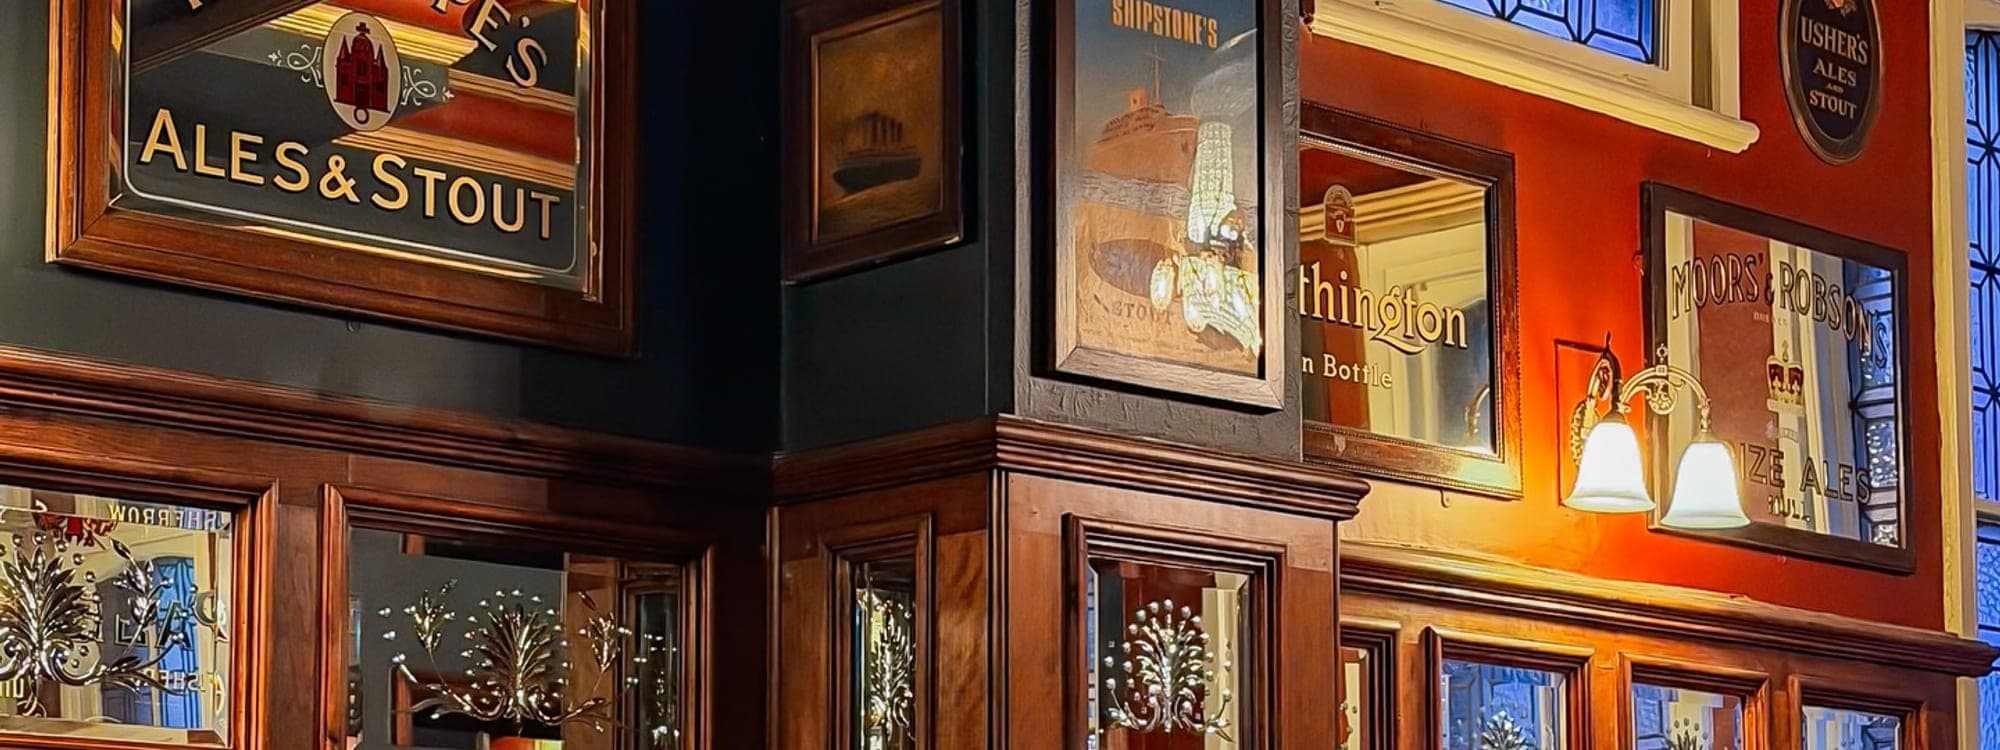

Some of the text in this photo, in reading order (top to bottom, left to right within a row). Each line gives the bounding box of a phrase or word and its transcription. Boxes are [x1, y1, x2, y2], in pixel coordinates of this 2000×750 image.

[1112, 0, 1217, 49] SHIPSTONE'S
[1801, 16, 1868, 64] USHER'S
[1813, 58, 1857, 86] ALES
[1810, 90, 1857, 119] STOUT
[140, 108, 560, 238] ALES & STOUT
[1671, 252, 1763, 320] MOORS'
[1779, 261, 1889, 369] ROBSON'S
[1323, 353, 1393, 388] Bottle
[1739, 442, 1872, 505] IZE ALES
